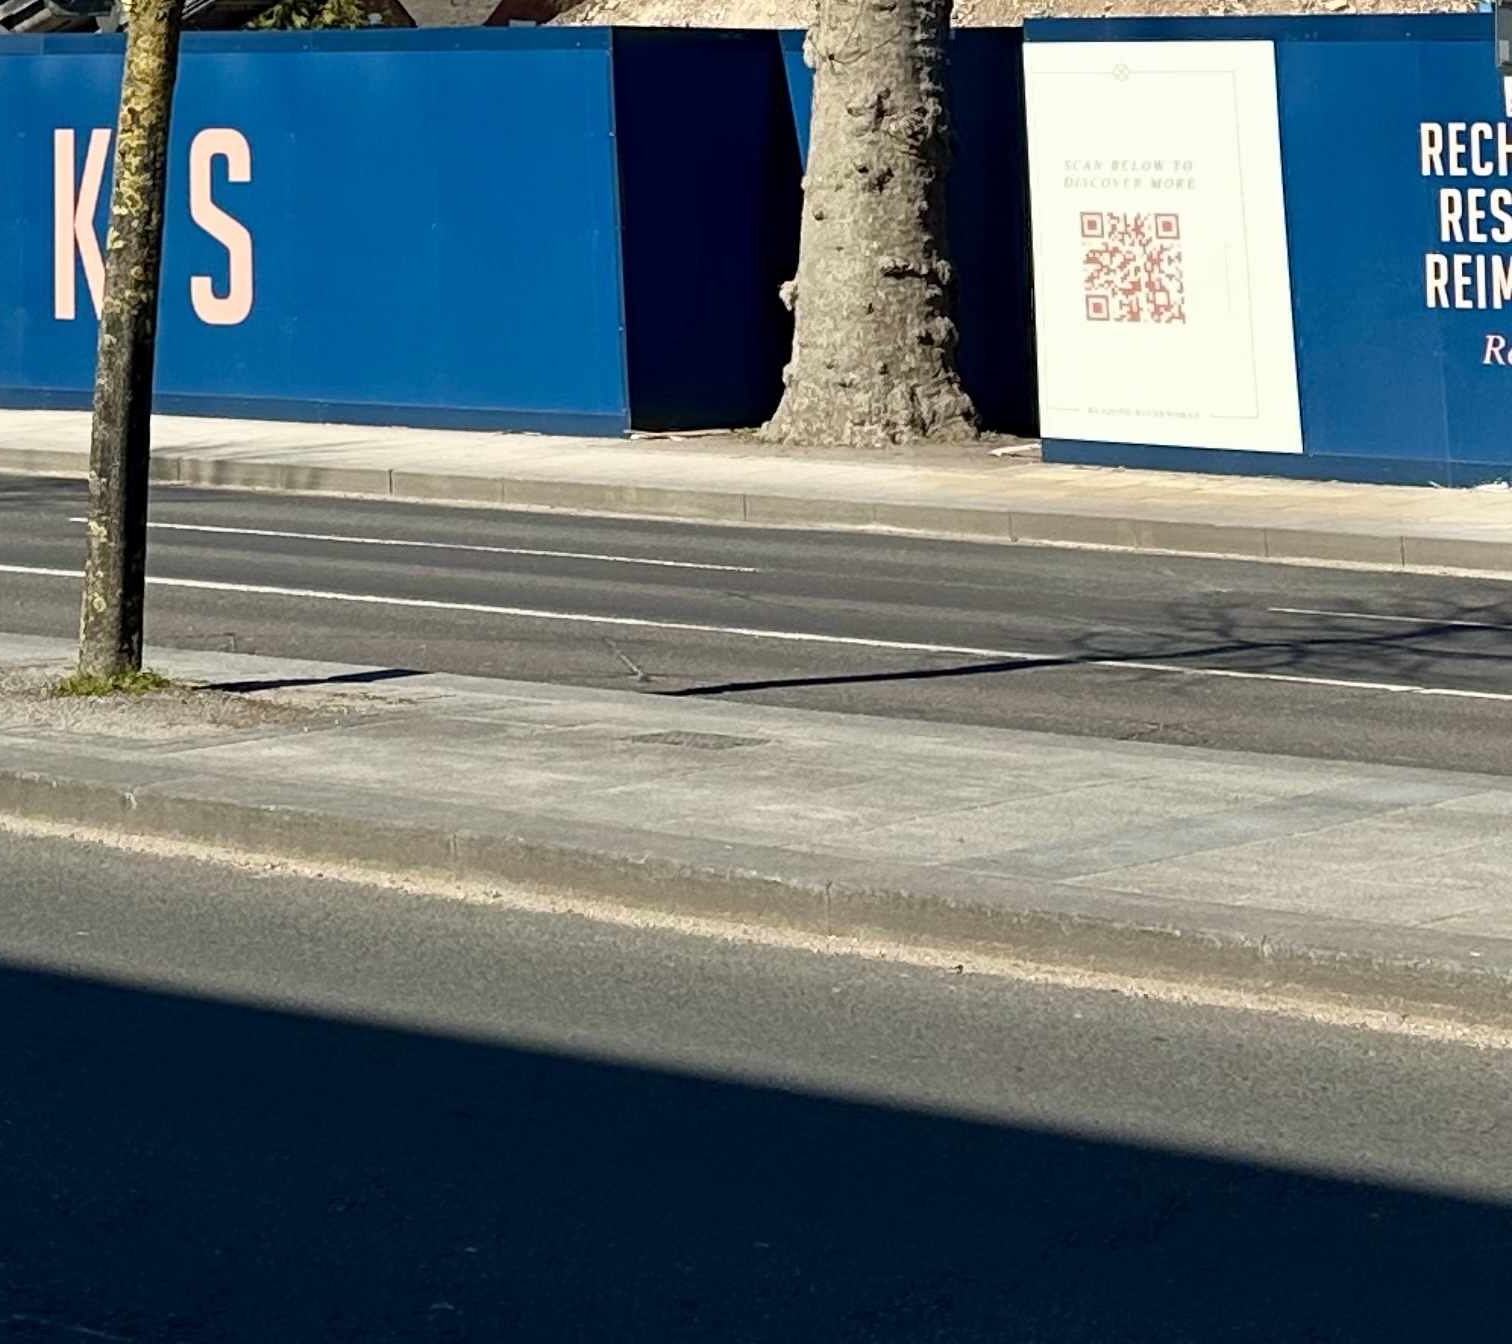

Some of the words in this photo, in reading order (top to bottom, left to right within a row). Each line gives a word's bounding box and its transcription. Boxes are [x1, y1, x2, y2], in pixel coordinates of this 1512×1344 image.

[1063, 159, 1104, 172] SCAN
[1110, 159, 1166, 172] BELOW
[1173, 159, 1193, 173] TO
[1063, 175, 1143, 189] DISCOVER
[1149, 177, 1196, 190] MORE
[1439, 188, 1512, 243] RES
